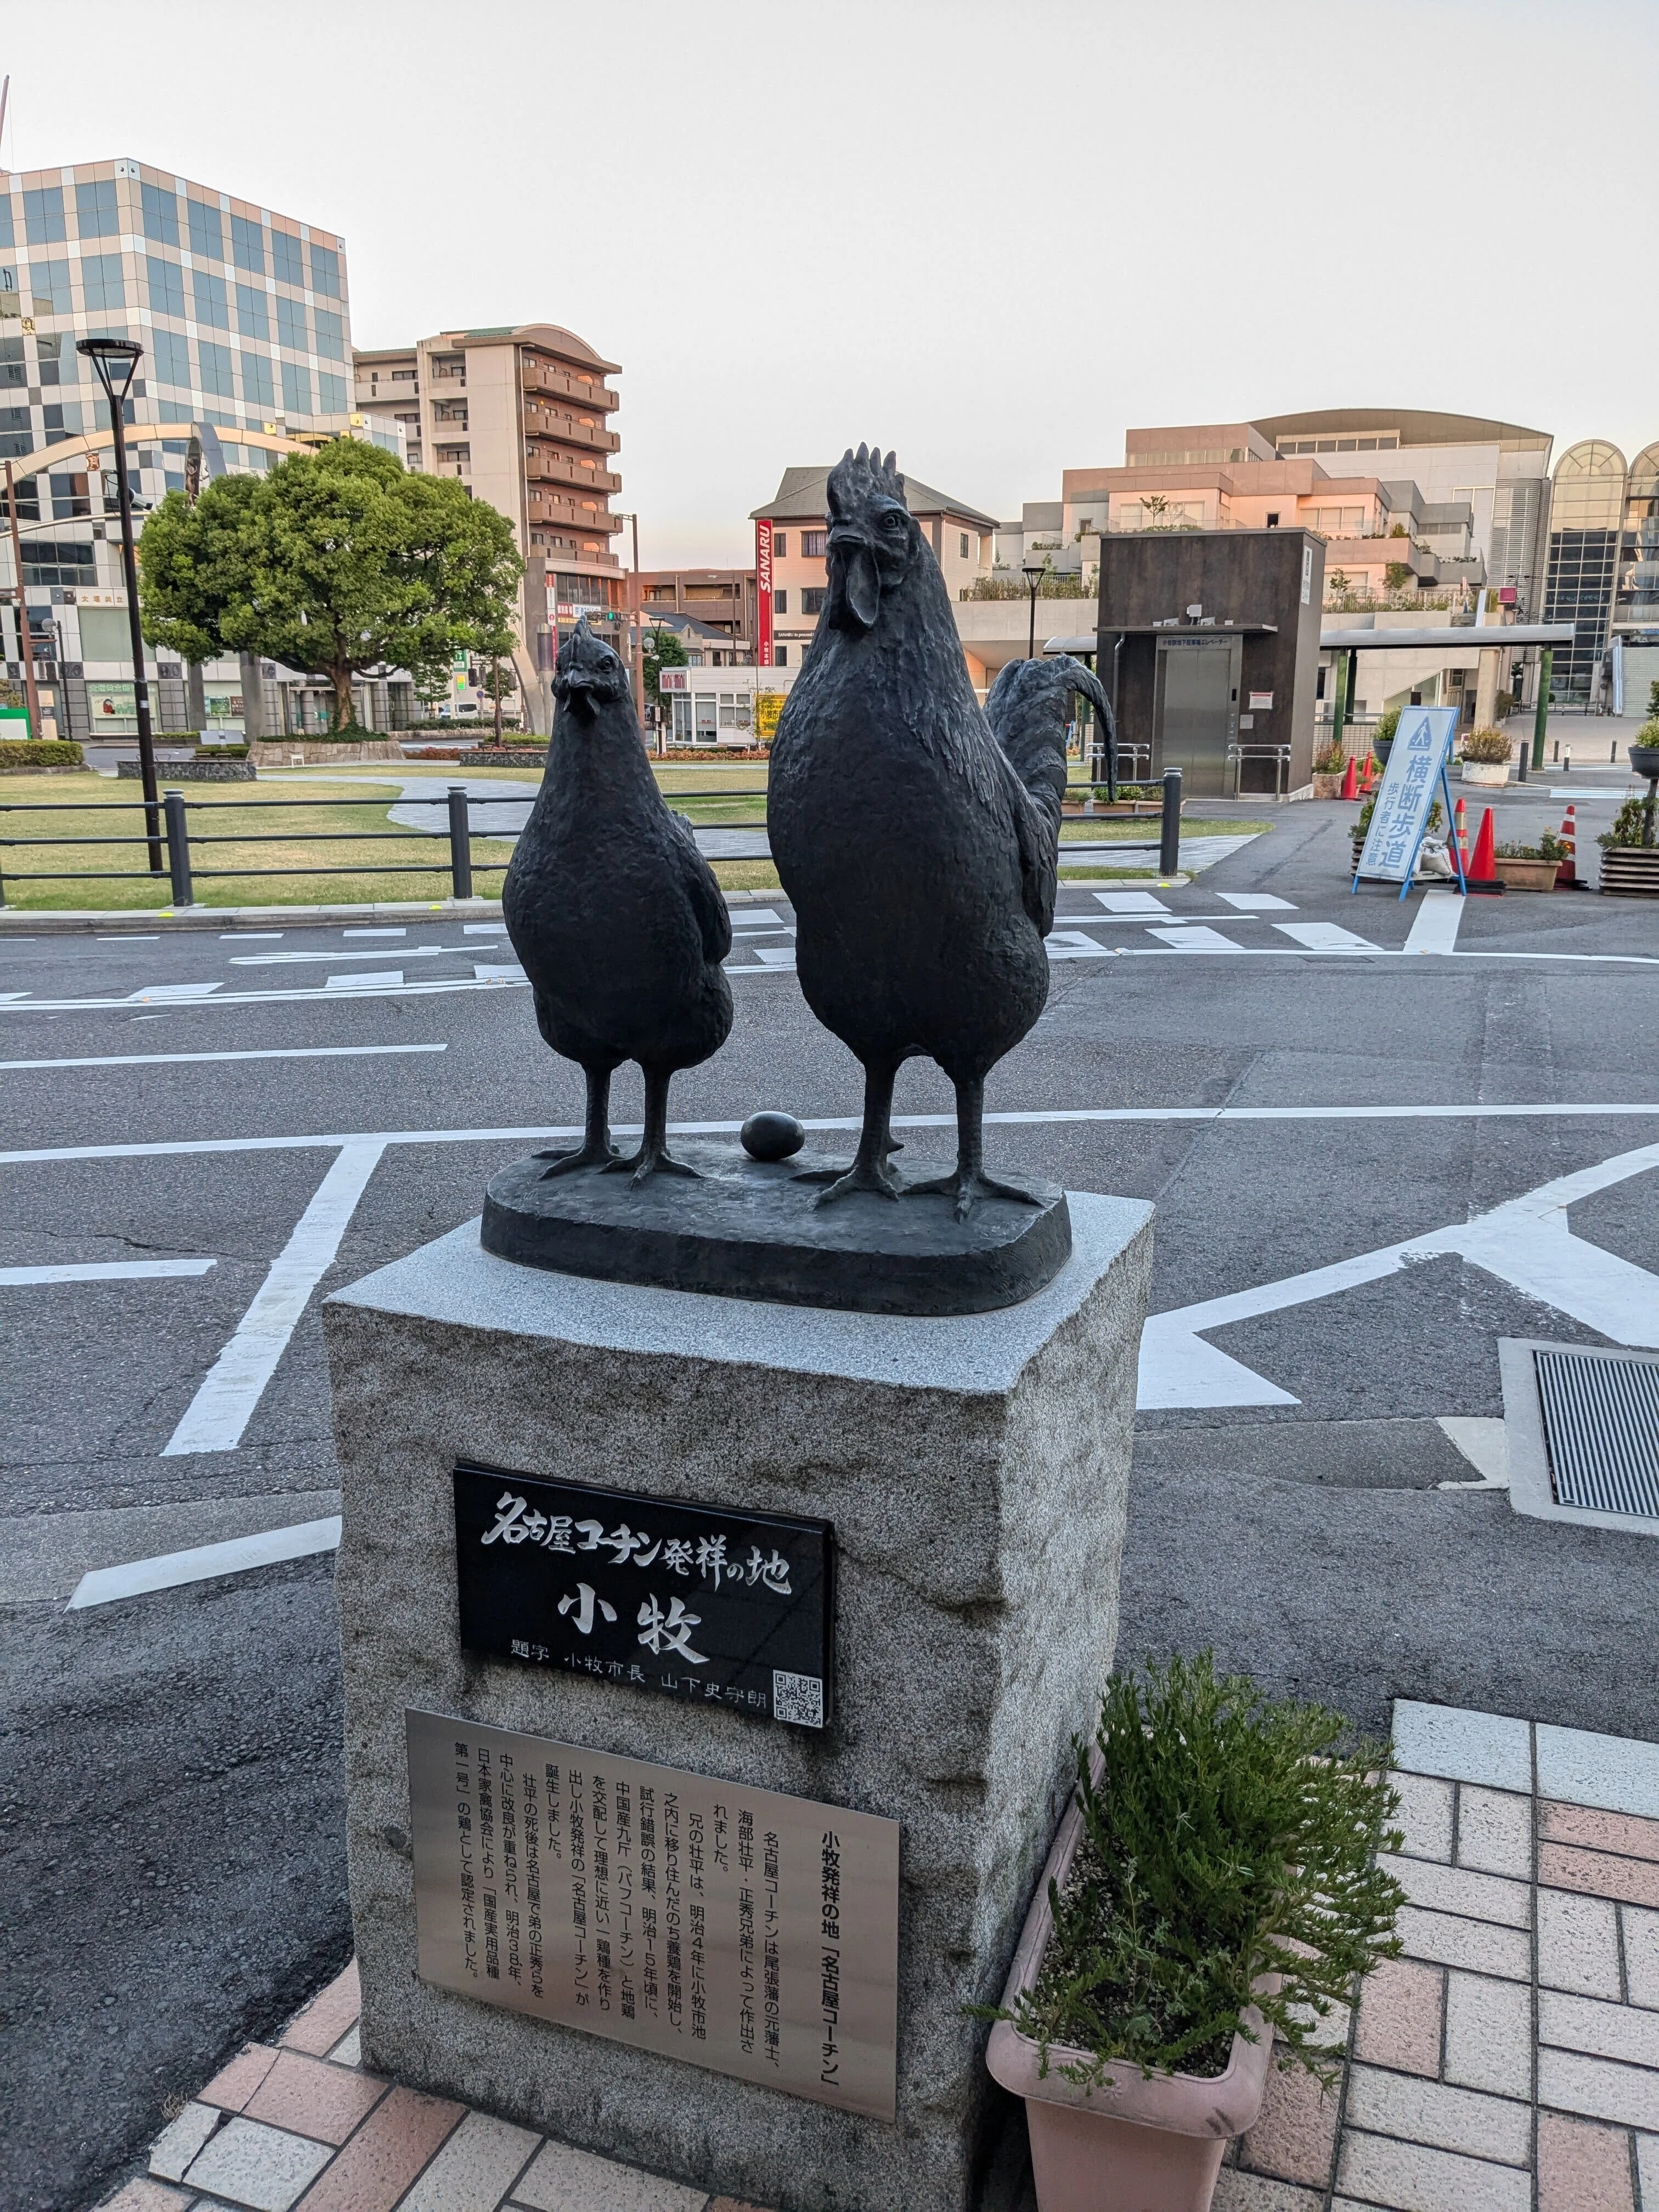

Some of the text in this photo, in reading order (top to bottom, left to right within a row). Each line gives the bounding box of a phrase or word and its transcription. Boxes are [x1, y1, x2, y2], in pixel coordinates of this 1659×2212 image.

[760, 525, 771, 593] SANARU
[1366, 782, 1399, 866] 歩行者に注意
[1378, 755, 1432, 869] 横断歩道
[511, 1639, 766, 1708] 題字 小牧市長 山下史守朗
[557, 1583, 710, 1664] 小牧
[455, 1741, 478, 1978] 第一号」の鶏として認定されました。
[545, 1763, 562, 1859] 誕生しました。
[713, 1804, 729, 1872] れました。
[522, 1773, 544, 1999] 壮平の死後は名古屋で弟の正秀らを
[569, 1769, 590, 2006] 出し小牧発祥の「名古屋コーチン」が
[664, 1792, 682, 2033] 之内に移り住んだのち養鶏を開始し、
[763, 1831, 780, 2067] 名古屋コーチンは尾張藩の元藩士、
[821, 1831, 840, 2085] 小牧発祥の地「名古屋コーチン」
